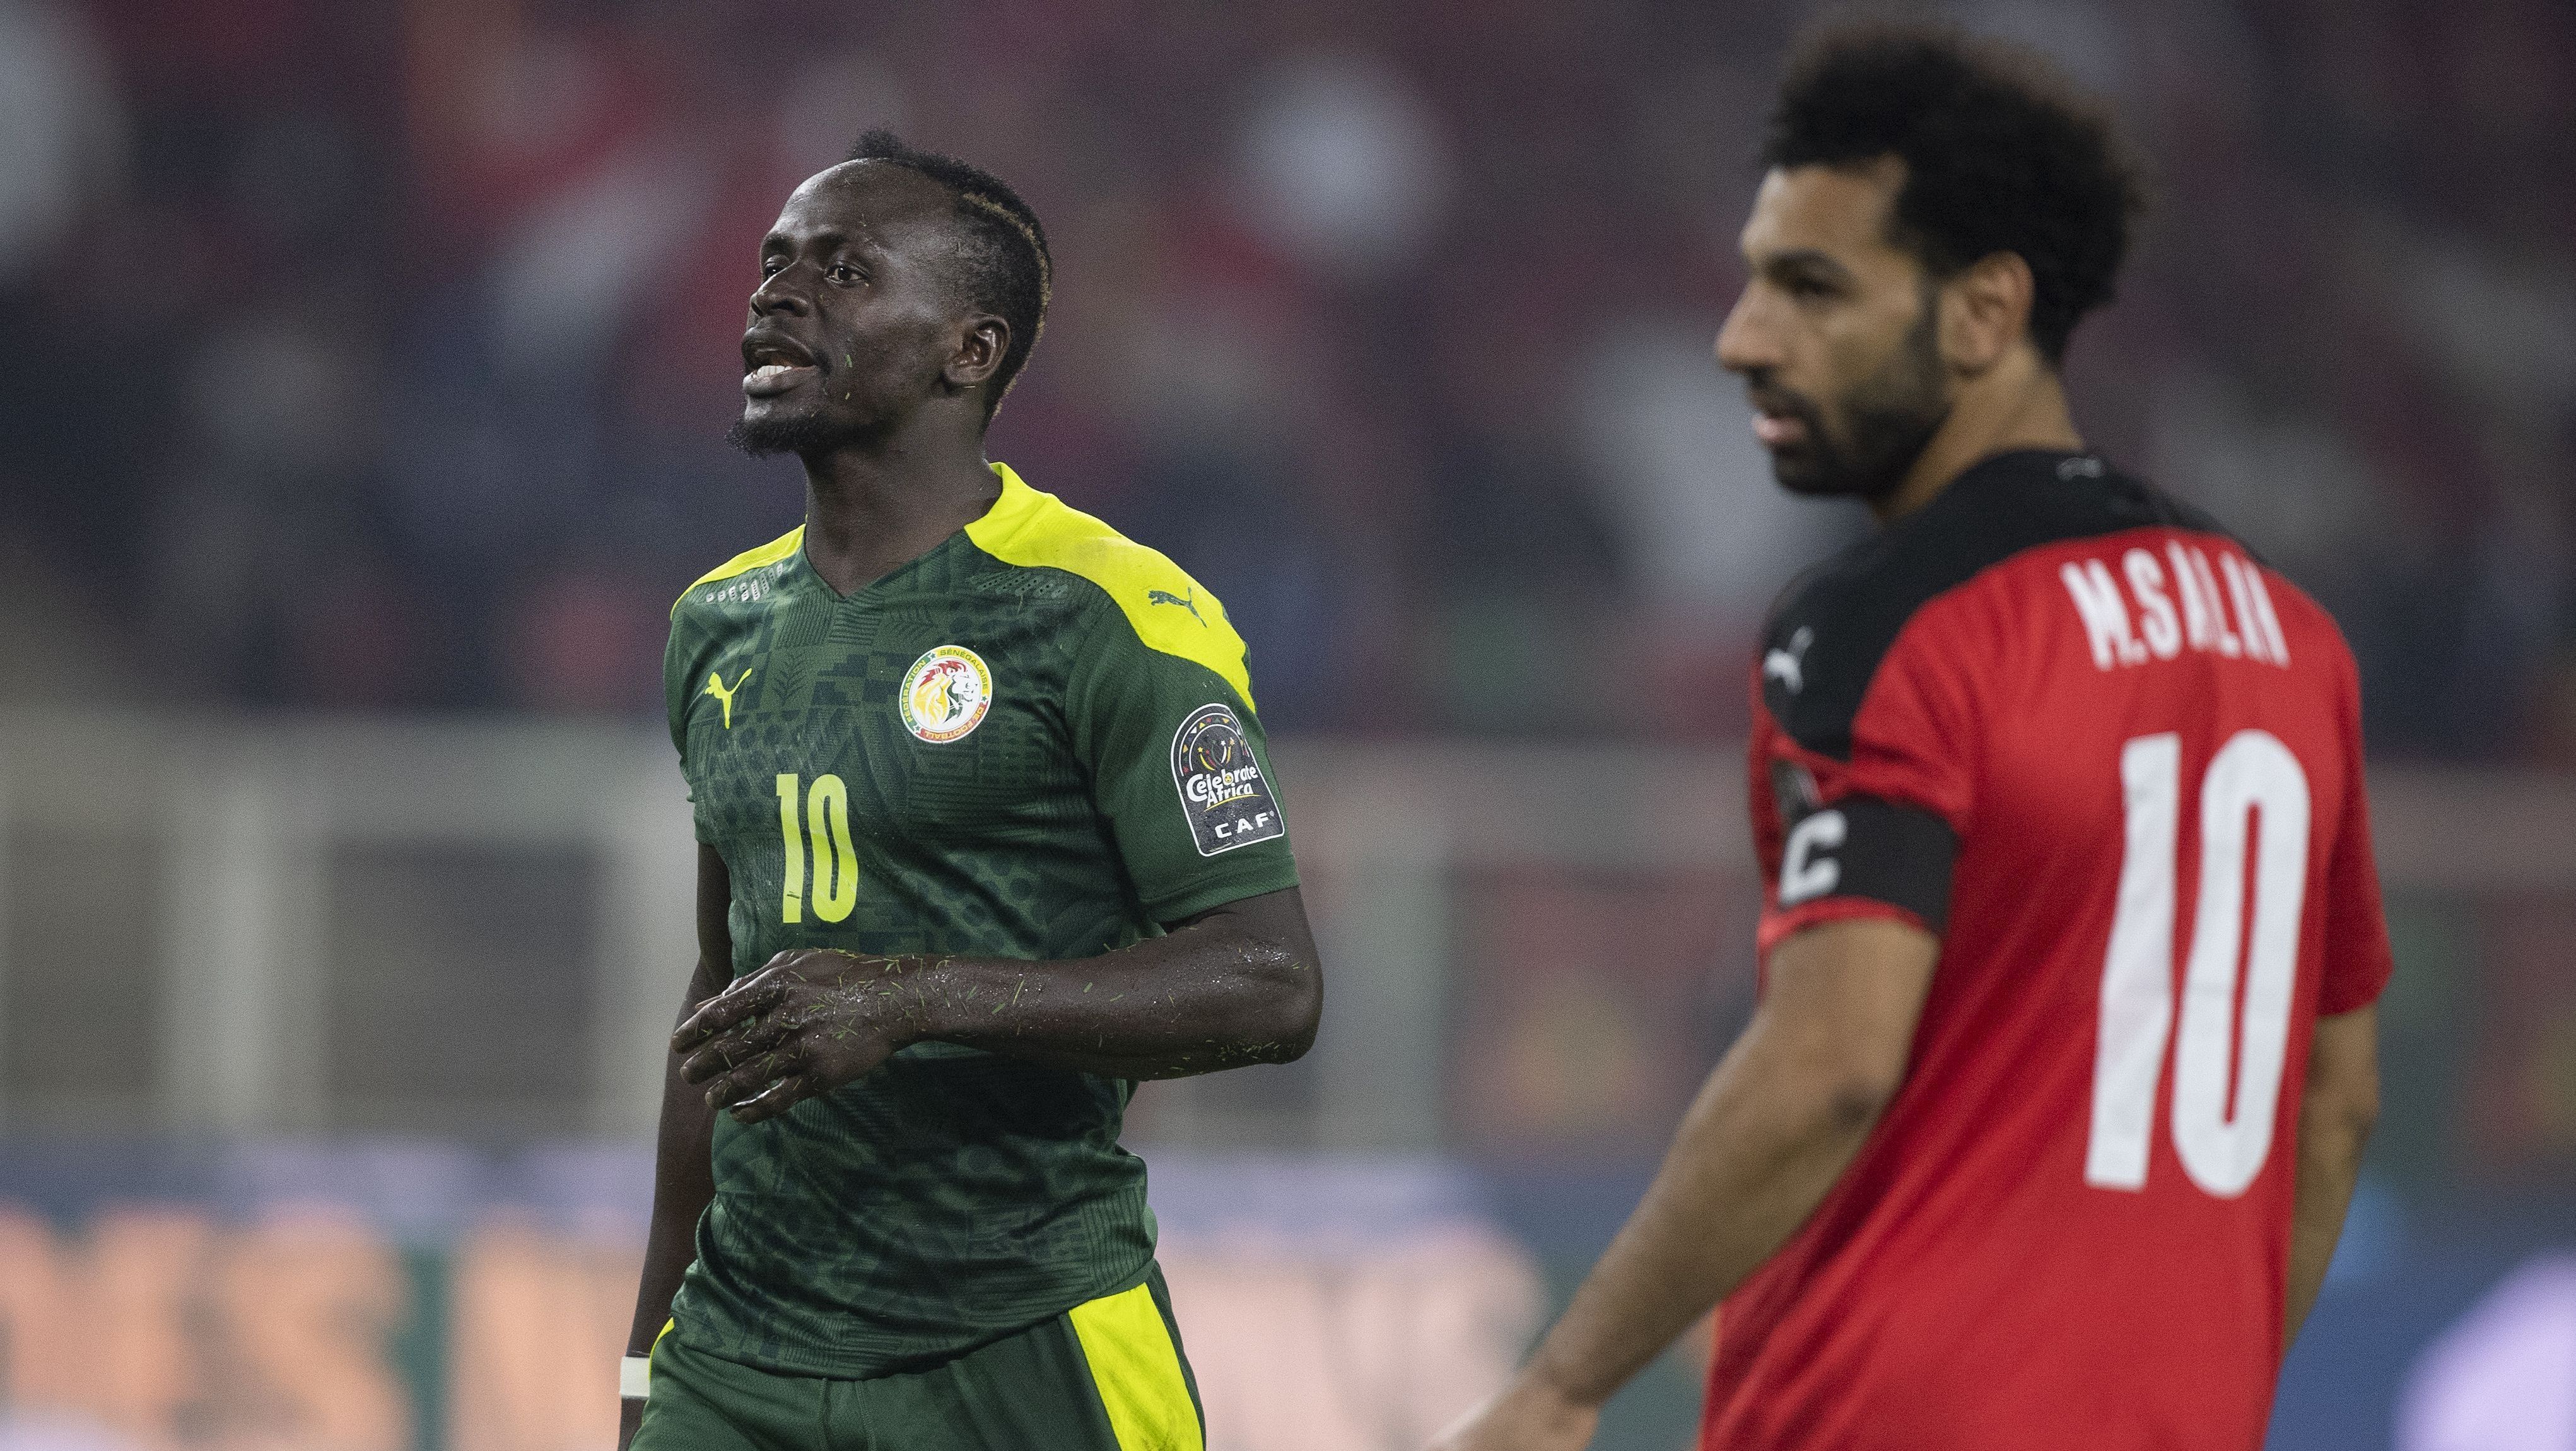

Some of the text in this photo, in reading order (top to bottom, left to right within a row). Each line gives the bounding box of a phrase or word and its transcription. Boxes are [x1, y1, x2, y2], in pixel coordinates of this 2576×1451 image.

[1186, 765, 1258, 802] Celebrate
[1206, 783, 1254, 808] Africa
[776, 773, 858, 922] 10
[1214, 812, 1269, 838] CAF
[1777, 808, 1847, 906] C
[2085, 729, 2311, 1199] 10
